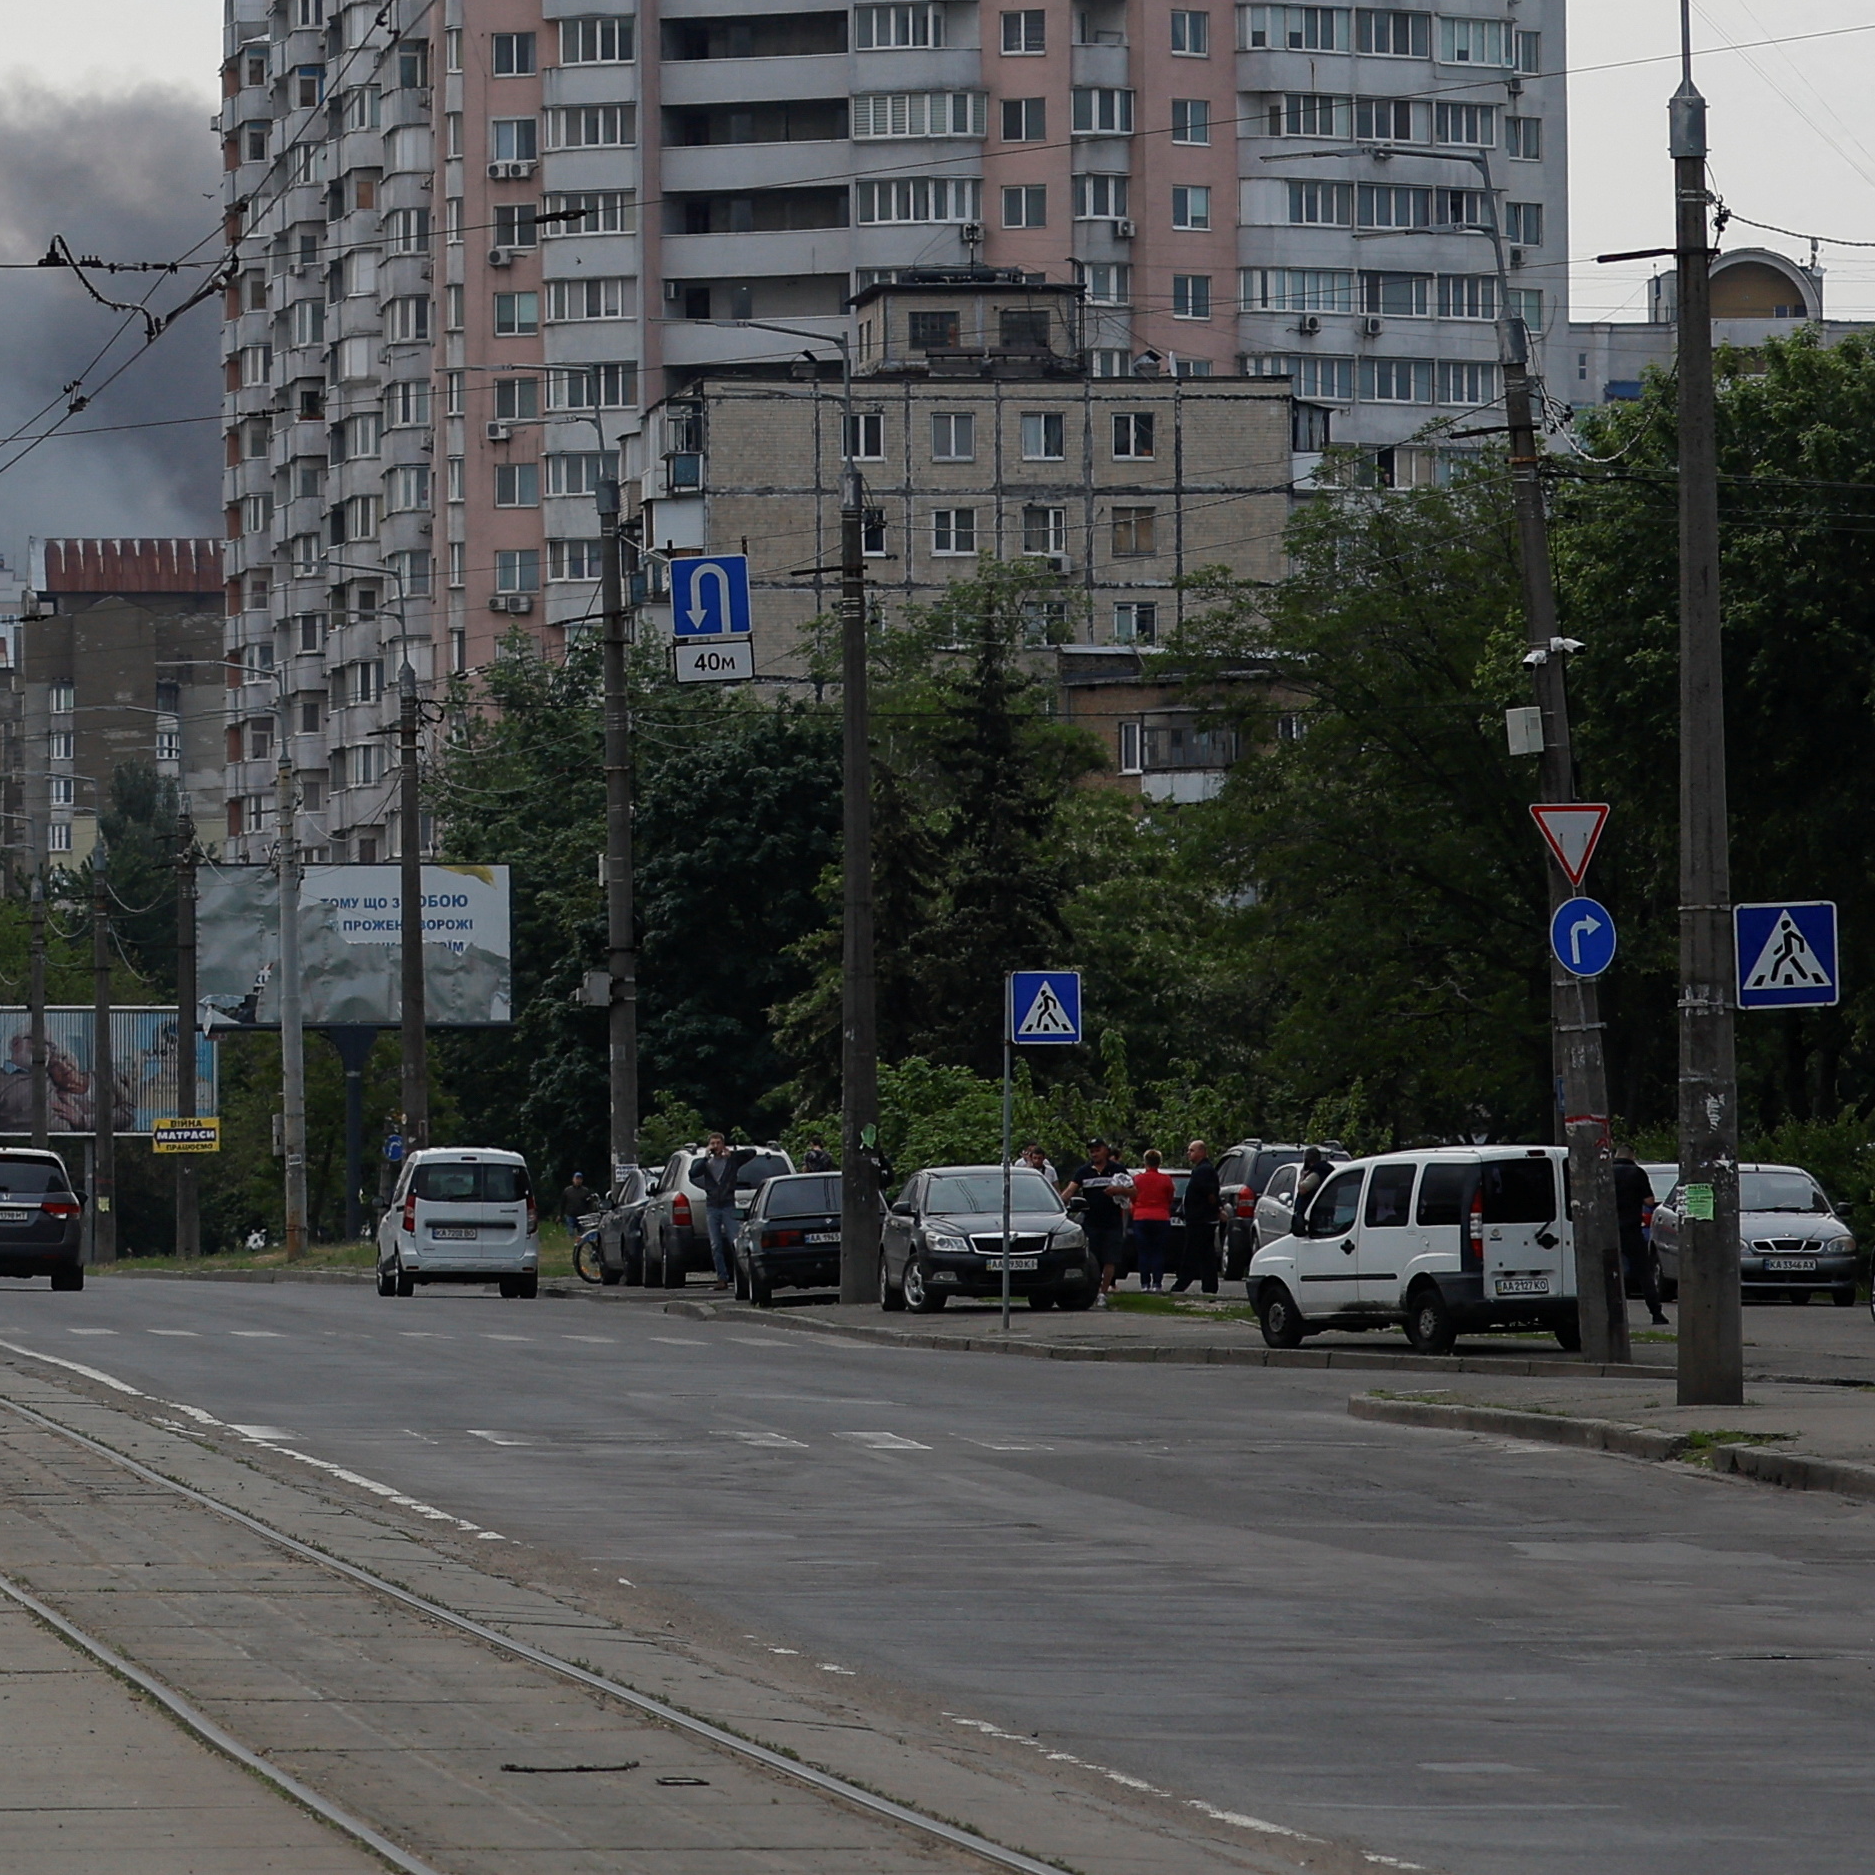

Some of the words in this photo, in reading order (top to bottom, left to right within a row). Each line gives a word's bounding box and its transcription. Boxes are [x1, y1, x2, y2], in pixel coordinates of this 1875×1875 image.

[364, 898, 388, 910] ЩО
[419, 894, 468, 908] ОБОЮ
[170, 1120, 202, 1128] ВІЙНА
[156, 1130, 215, 1140] МАТРАСИ
[1503, 1282, 1514, 1291] AA
